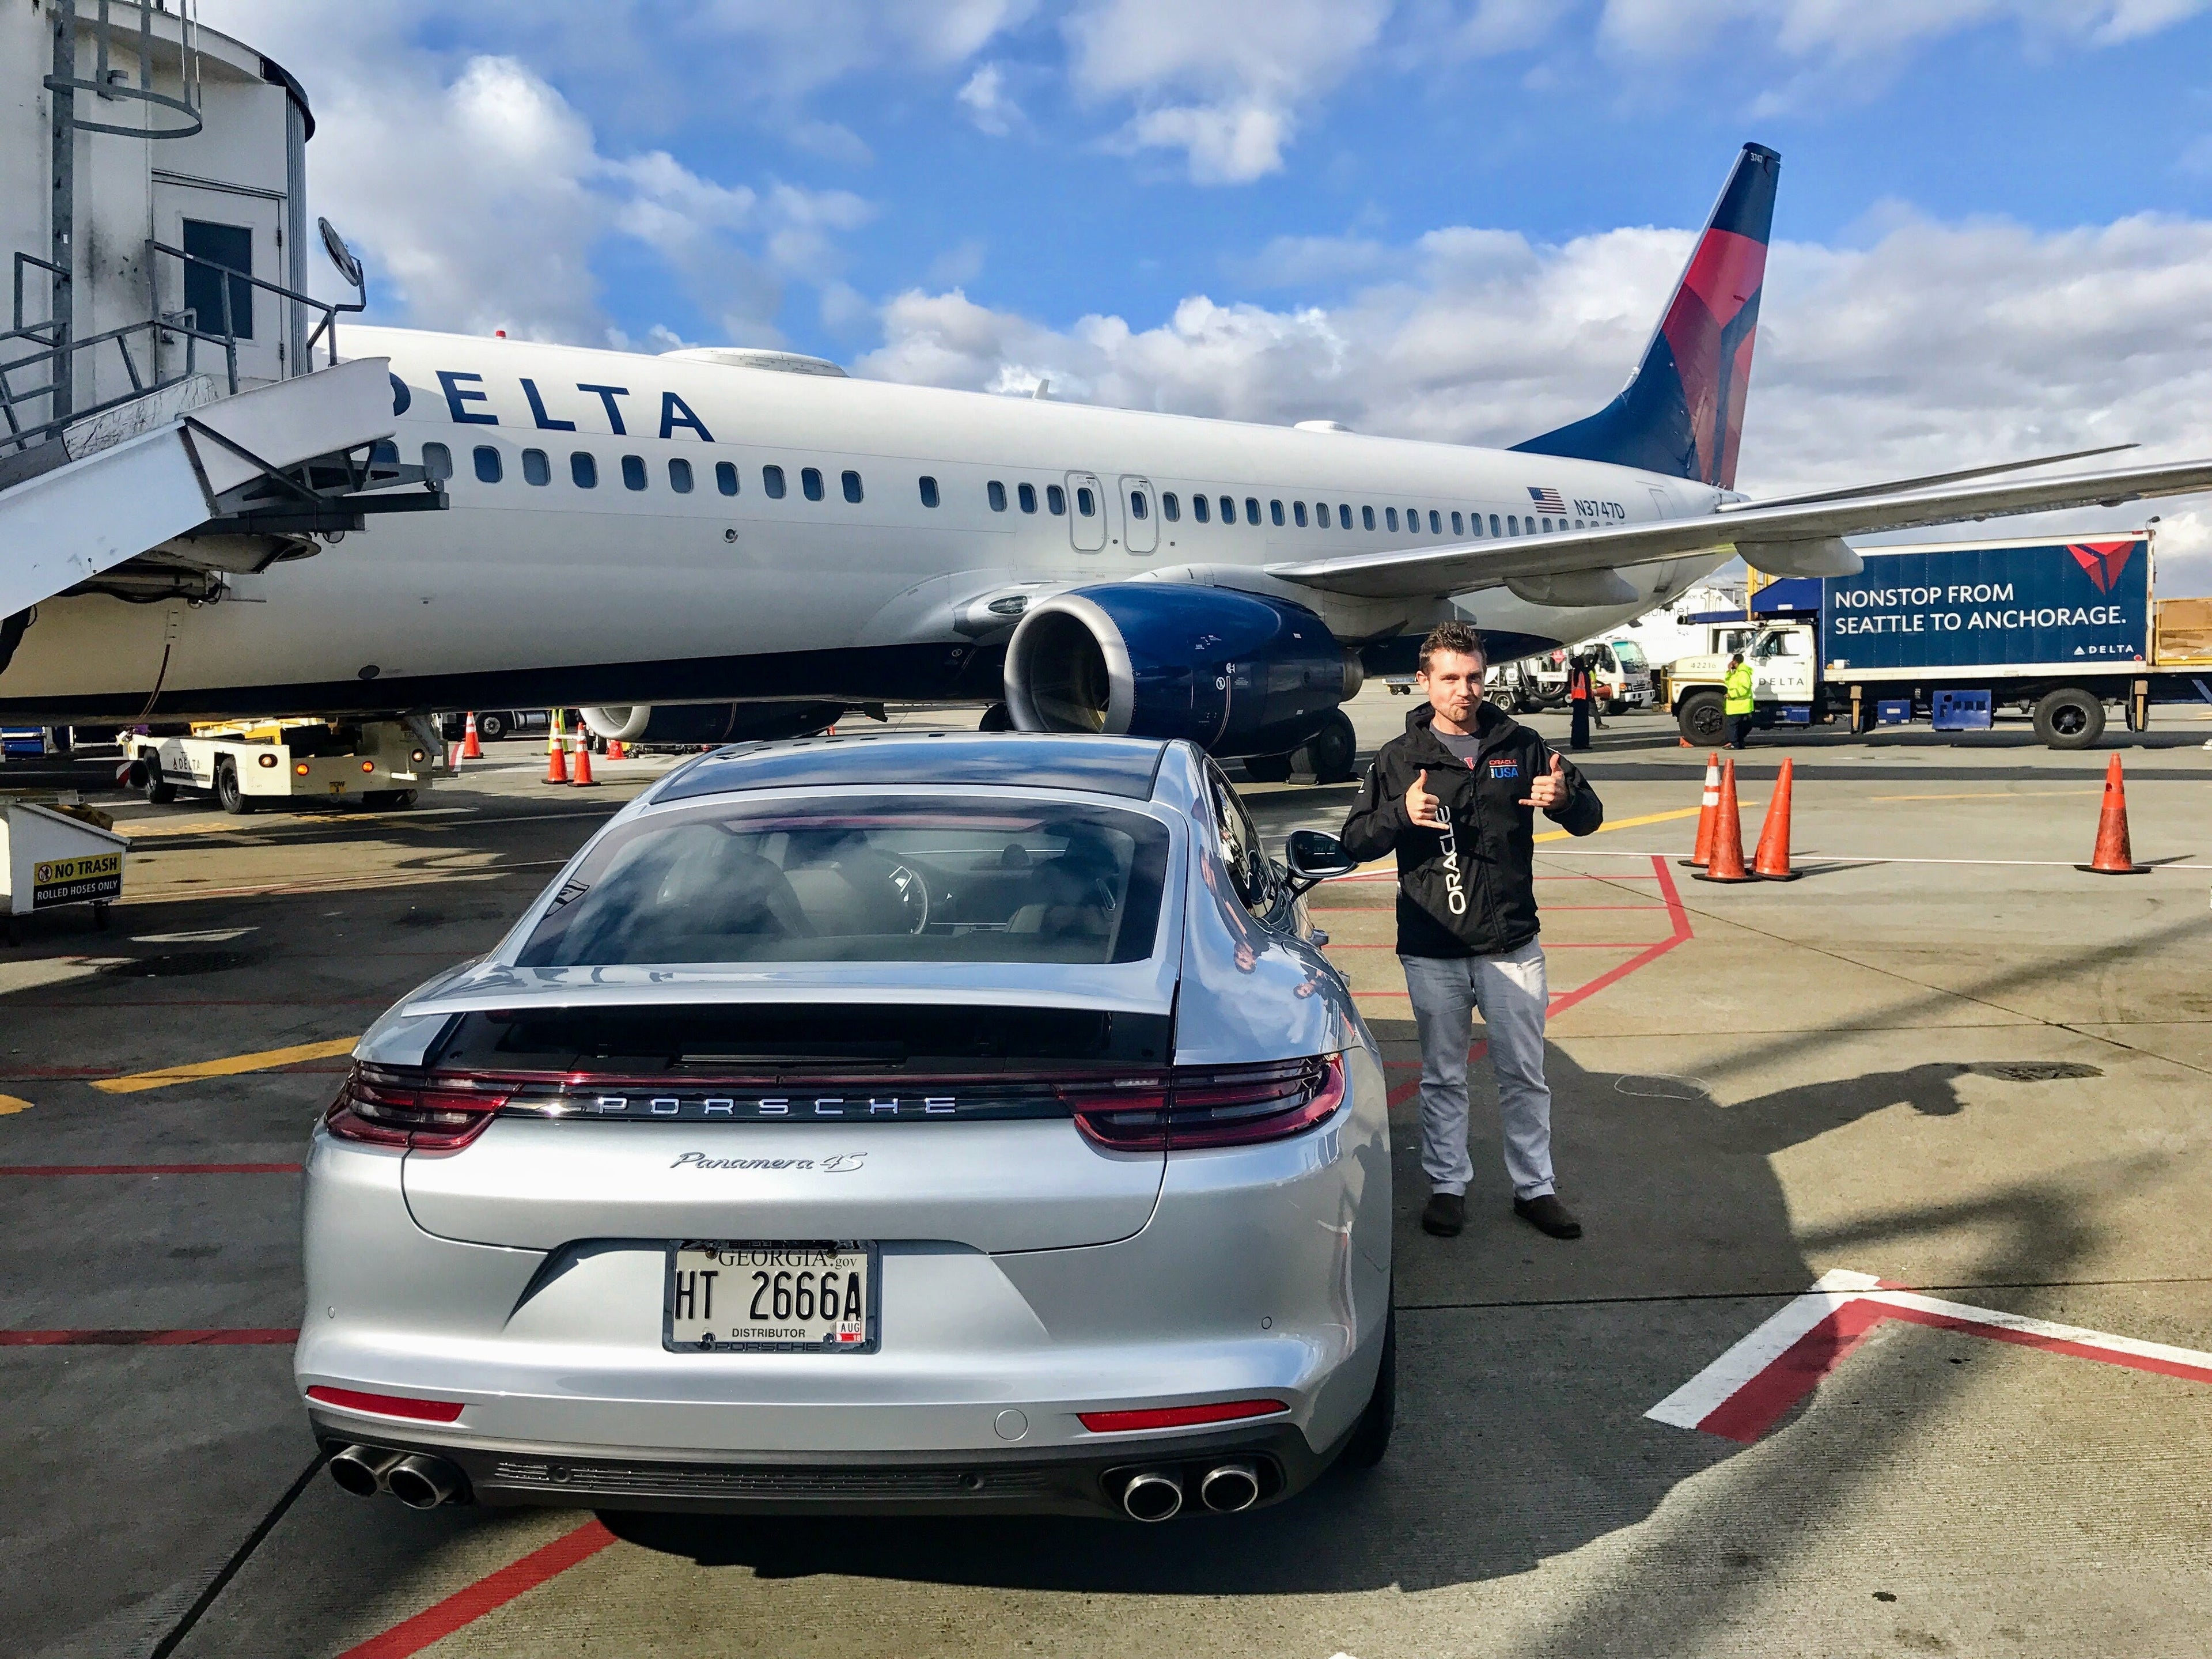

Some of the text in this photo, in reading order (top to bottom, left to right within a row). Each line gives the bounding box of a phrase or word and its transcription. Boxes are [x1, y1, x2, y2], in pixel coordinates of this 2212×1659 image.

[1574, 499, 1626, 519] N3747D
[1835, 583, 2014, 609] NONSTOP FROM
[1835, 605, 2126, 635] SEATTLE TO ANCHORAGE.
[2088, 644, 2134, 654] DELTA
[1759, 677, 1804, 686] DELTA
[1494, 767, 1519, 779] USA
[55, 857, 118, 879] NO TRASH
[1435, 805, 1467, 915] ORACLE
[37, 880, 118, 901] ROLLED HOSES ONLY
[599, 1097, 956, 1116] PORSCHE
[669, 1152, 868, 1173] Panamera 4S
[675, 1270, 861, 1321] HT 2666A
[732, 1328, 806, 1338] DISTRIBUTOR
[840, 1323, 860, 1332] AUG
[715, 1342, 821, 1351] PORSCHE
